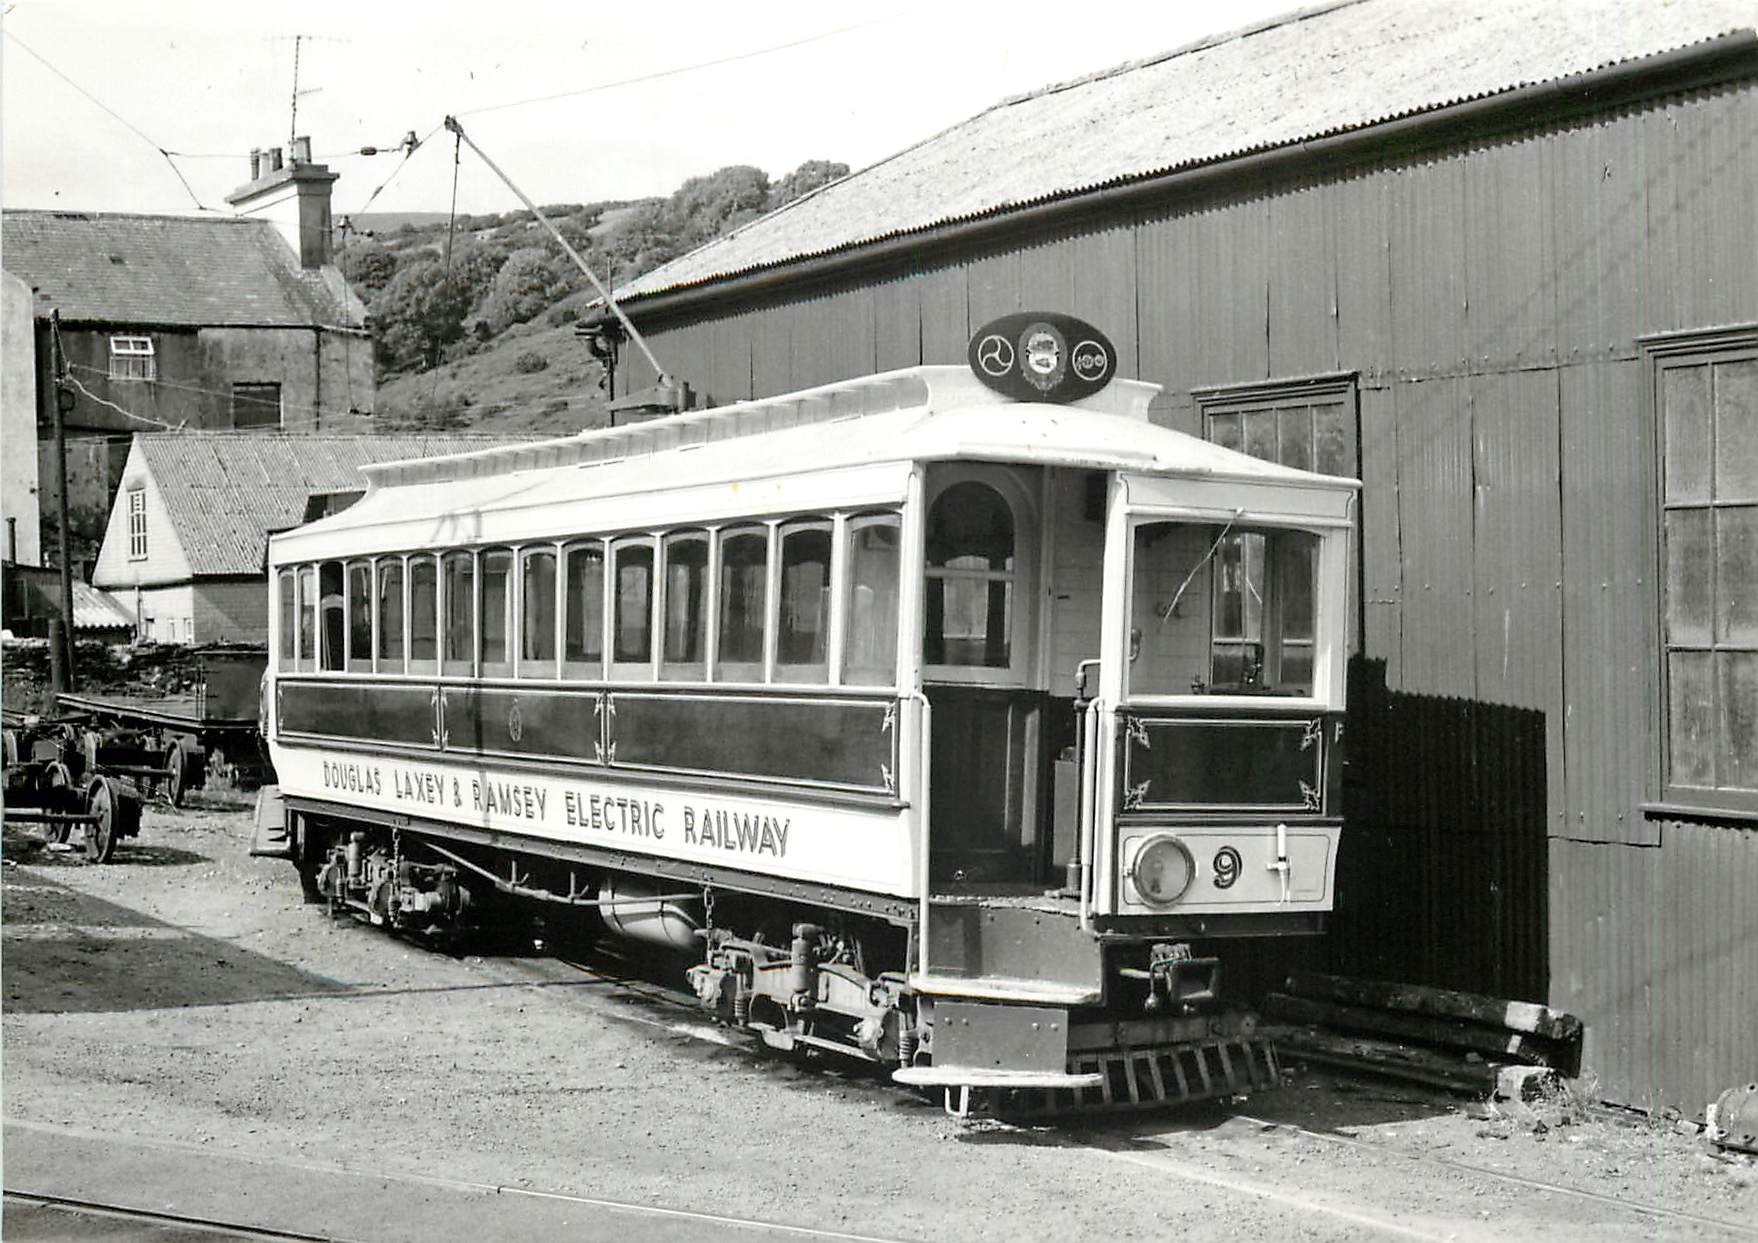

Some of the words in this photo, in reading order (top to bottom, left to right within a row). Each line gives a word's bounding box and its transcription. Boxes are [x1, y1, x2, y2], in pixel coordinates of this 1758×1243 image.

[323, 760, 382, 796] DOUGLAS
[394, 769, 446, 806] LAXEY
[453, 777, 463, 806] &
[473, 778, 548, 822] RAMSEY
[564, 790, 666, 840] ELECTRIC
[683, 806, 791, 858] RAILWAY
[1213, 846, 1242, 889] 9
